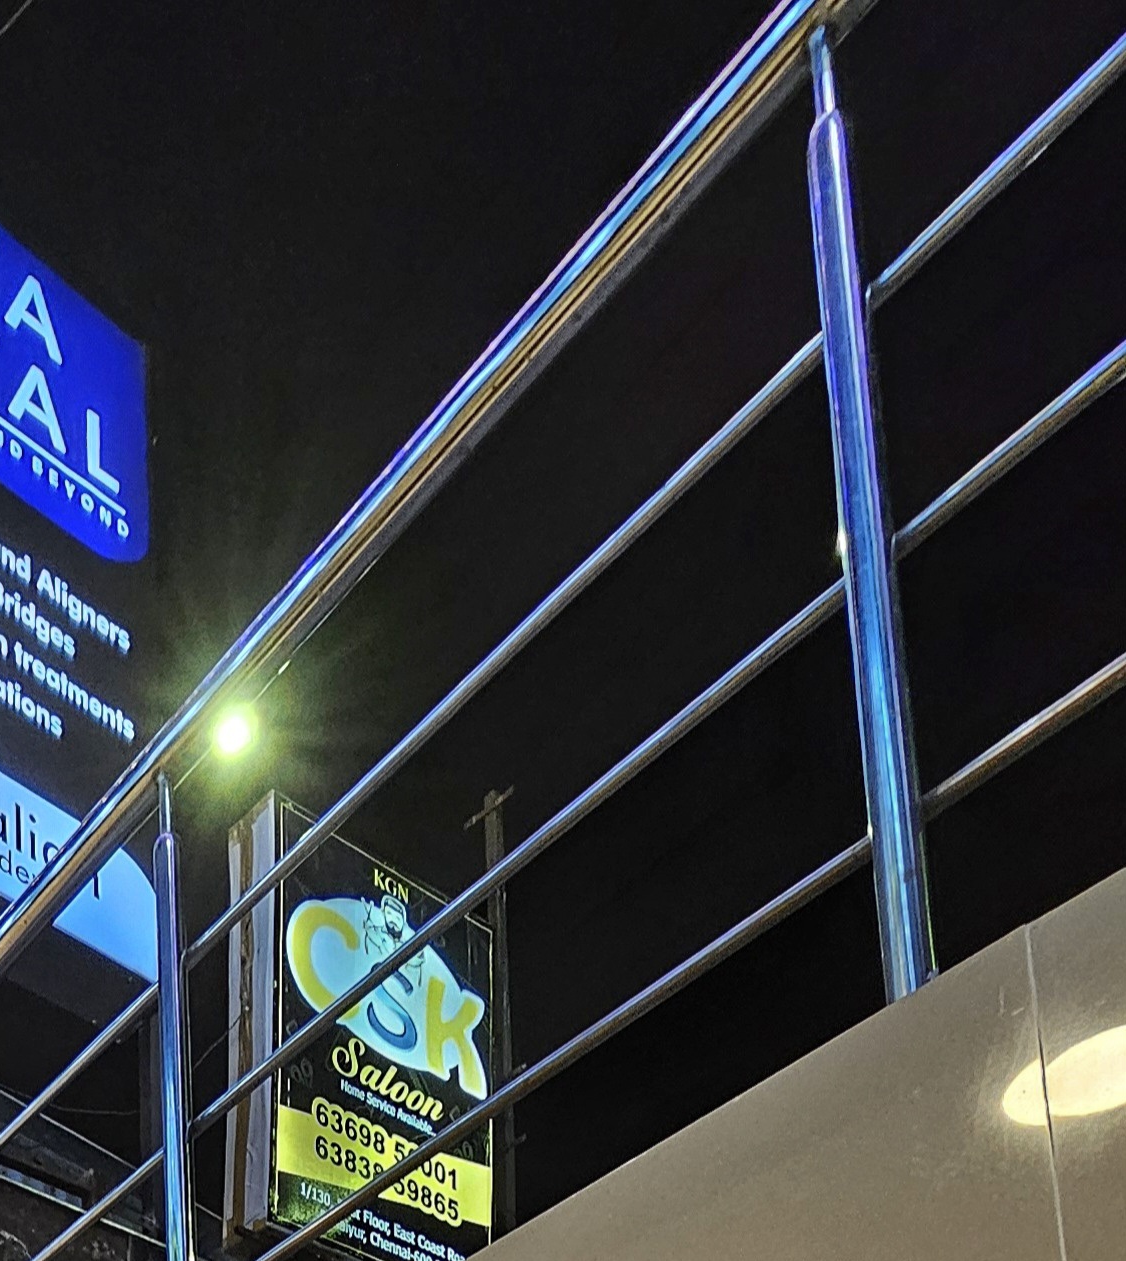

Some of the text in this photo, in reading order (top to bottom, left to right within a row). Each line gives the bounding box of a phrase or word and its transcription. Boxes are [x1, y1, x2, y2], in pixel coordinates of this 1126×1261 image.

[32, 455, 130, 538] BEYOND
[36, 568, 131, 652] Aligners
[14, 641, 135, 741] treatments
[374, 868, 410, 904] KGN
[291, 904, 483, 1098] CSK
[331, 1037, 445, 1122] Saloon
[340, 1078, 365, 1101] Home
[366, 1092, 396, 1118] Service
[315, 1103, 458, 1191] 63698 5001
[363, 1209, 390, 1237] Floor,
[393, 1222, 416, 1245] East
[417, 1234, 445, 1259] Coast
